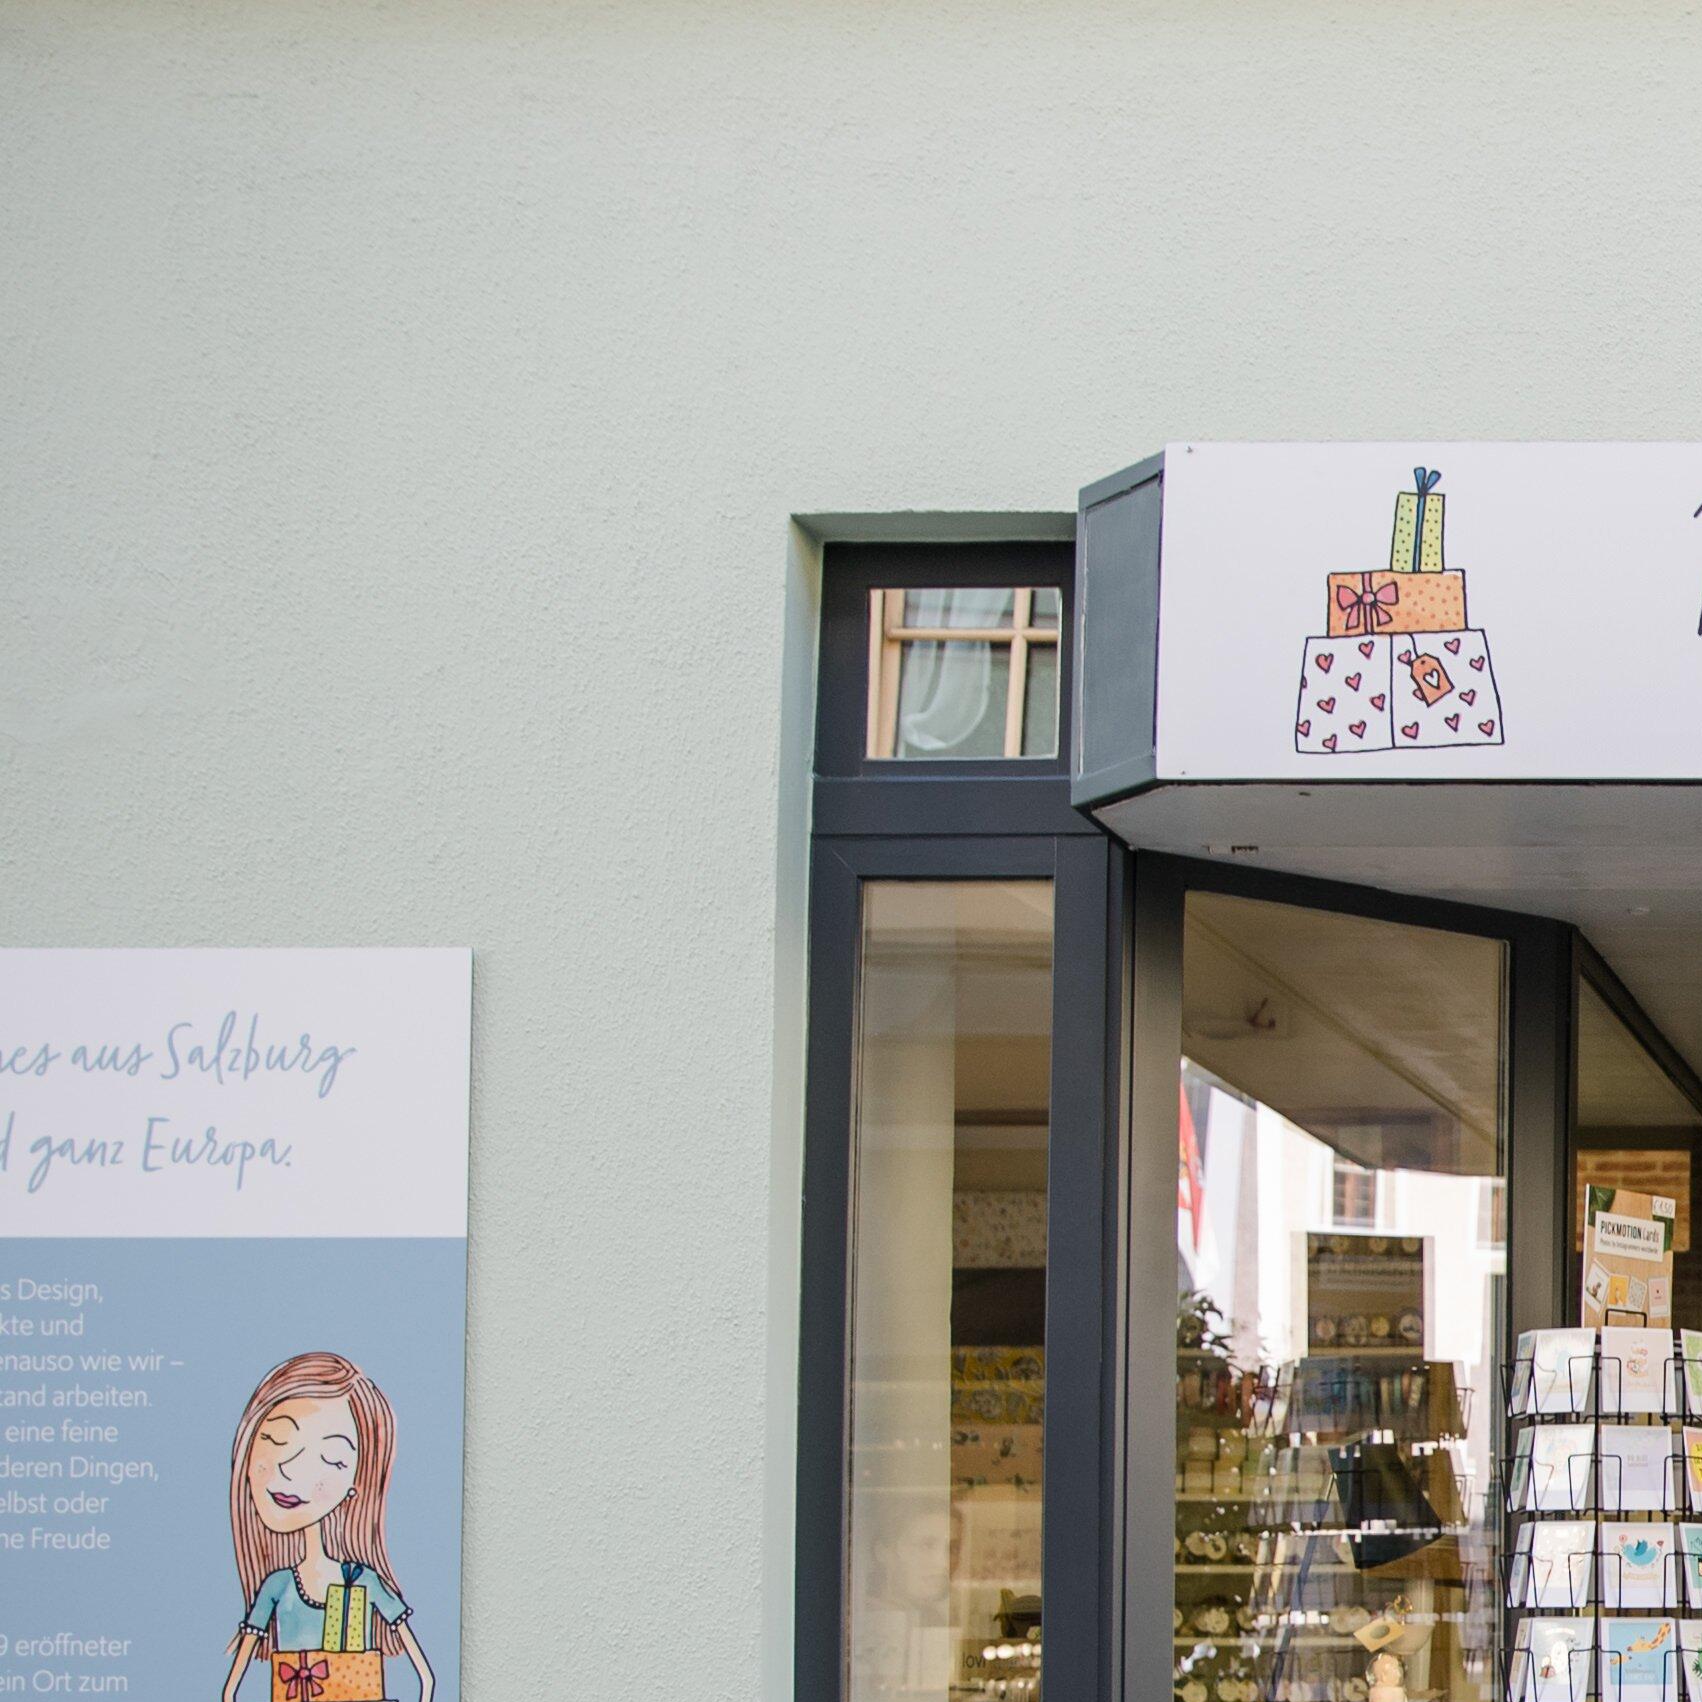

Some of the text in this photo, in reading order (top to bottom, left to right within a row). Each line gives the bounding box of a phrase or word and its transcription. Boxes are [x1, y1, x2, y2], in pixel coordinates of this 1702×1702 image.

[70, 1042, 154, 1078] aus
[160, 1009, 358, 1100] Salzburg
[27, 1135, 125, 1195] ganz
[141, 1116, 293, 1192] Europa.
[1600, 1220, 1642, 1241] PICKMOTION
[18, 1277, 104, 1307] Design,
[40, 1312, 84, 1336] und
[80, 1348, 122, 1371] wie
[128, 1348, 164, 1371] wir
[52, 1383, 153, 1407] arbeiten.
[5, 1418, 119, 1443] eine feine
[69, 1455, 160, 1485] Dingen,
[53, 1490, 110, 1514] oder
[31, 1525, 111, 1550] Freude
[15, 1633, 132, 1656] eröffneter
[32, 1669, 72, 1693] Ort
[78, 1674, 128, 1693] zum
